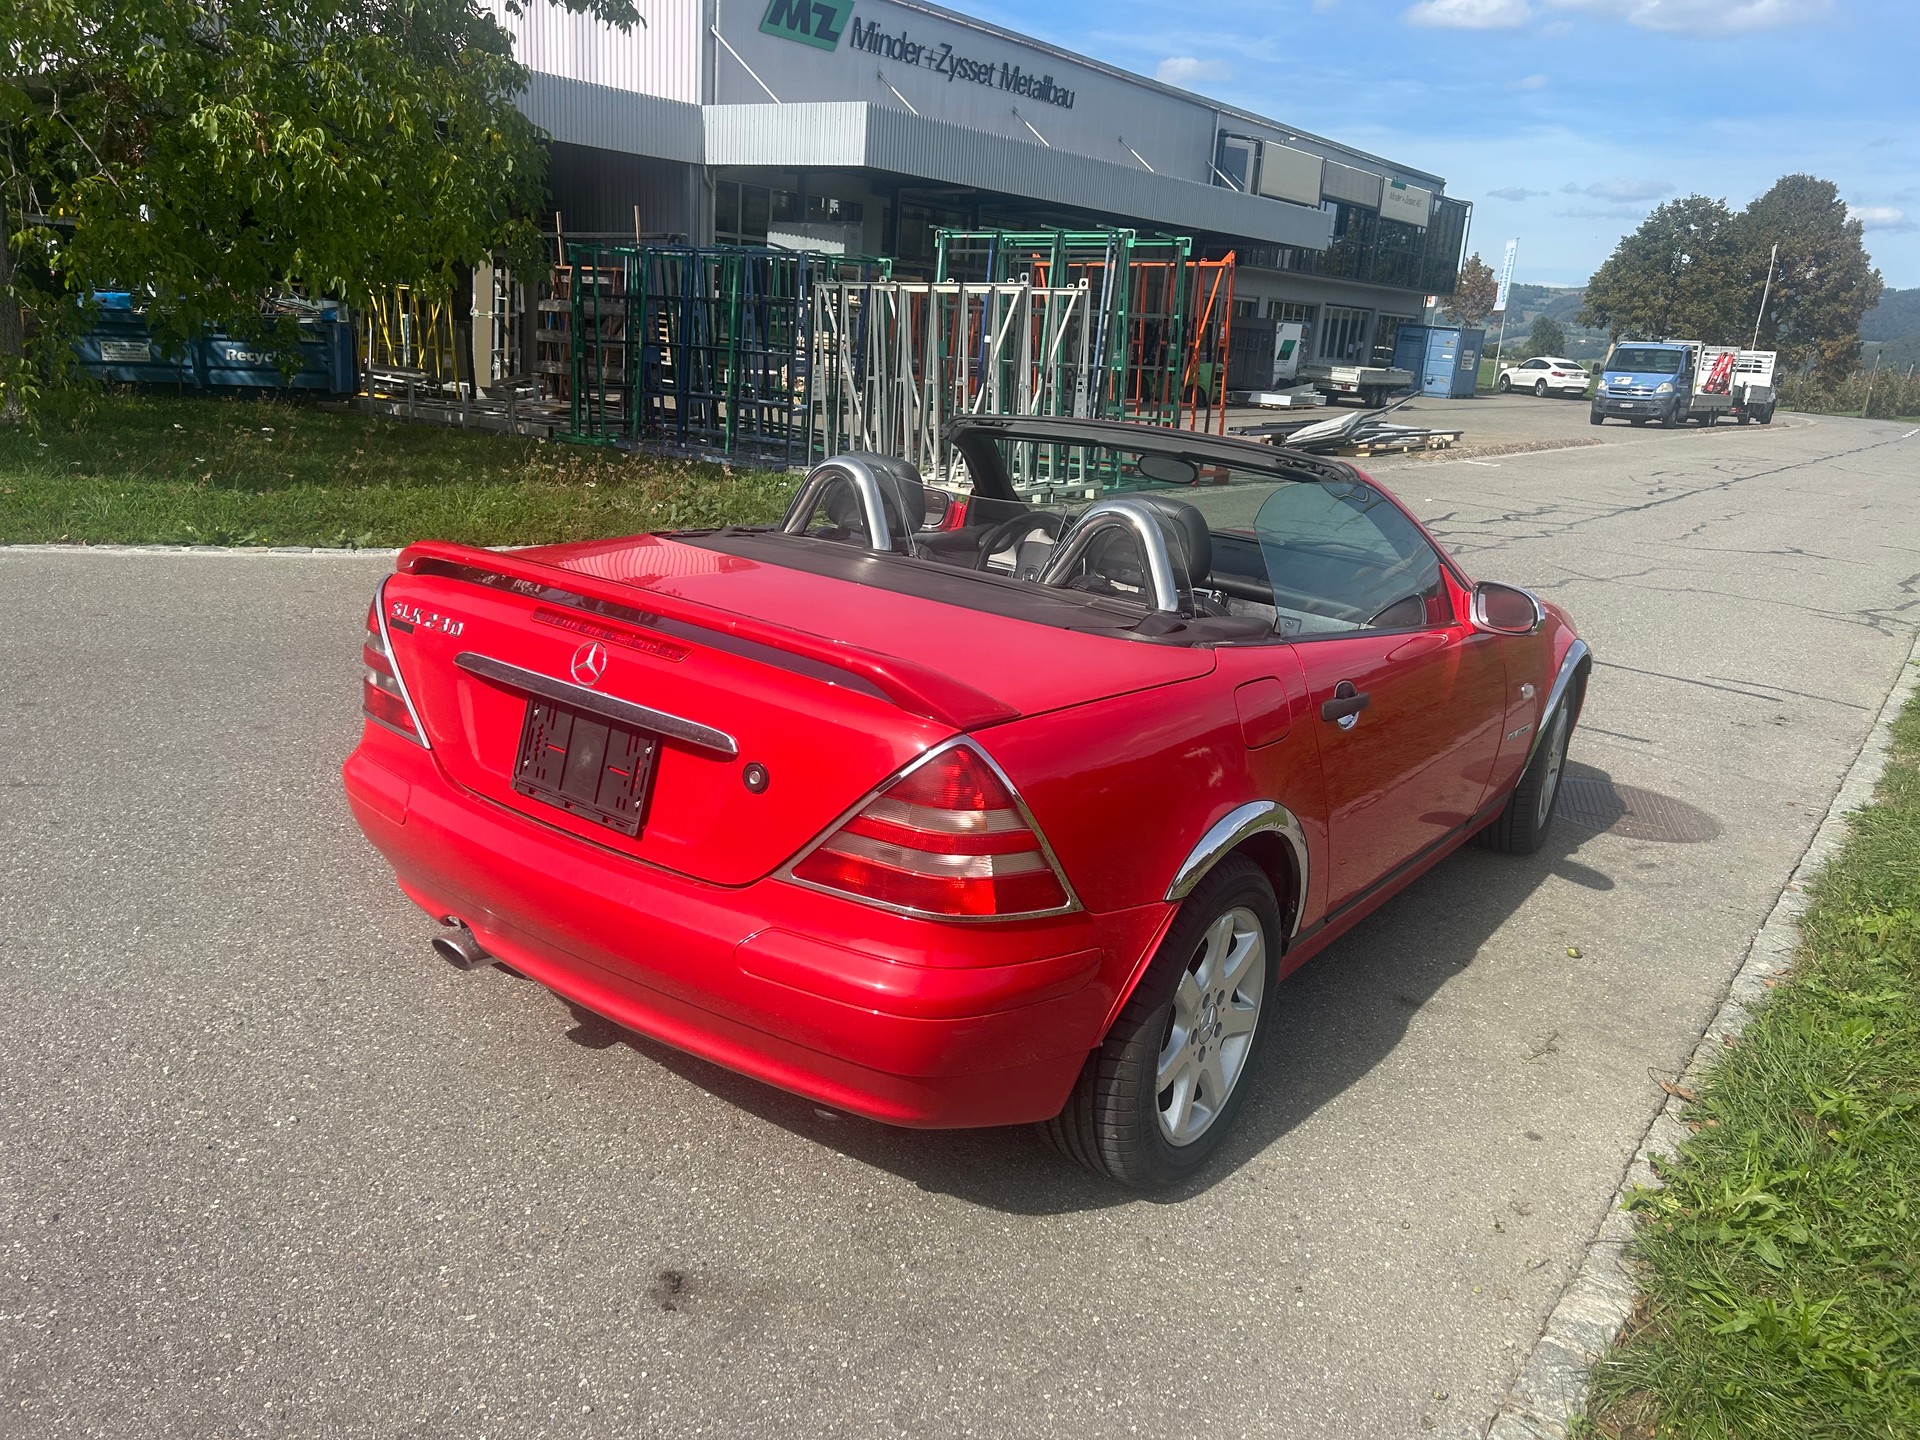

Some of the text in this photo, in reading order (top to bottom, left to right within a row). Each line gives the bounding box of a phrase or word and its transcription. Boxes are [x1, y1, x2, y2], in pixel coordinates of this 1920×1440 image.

[767, 0, 840, 43] MZ
[851, 16, 1076, 110] Minder+Zysset Metallbau
[391, 601, 465, 638] SLK 230
